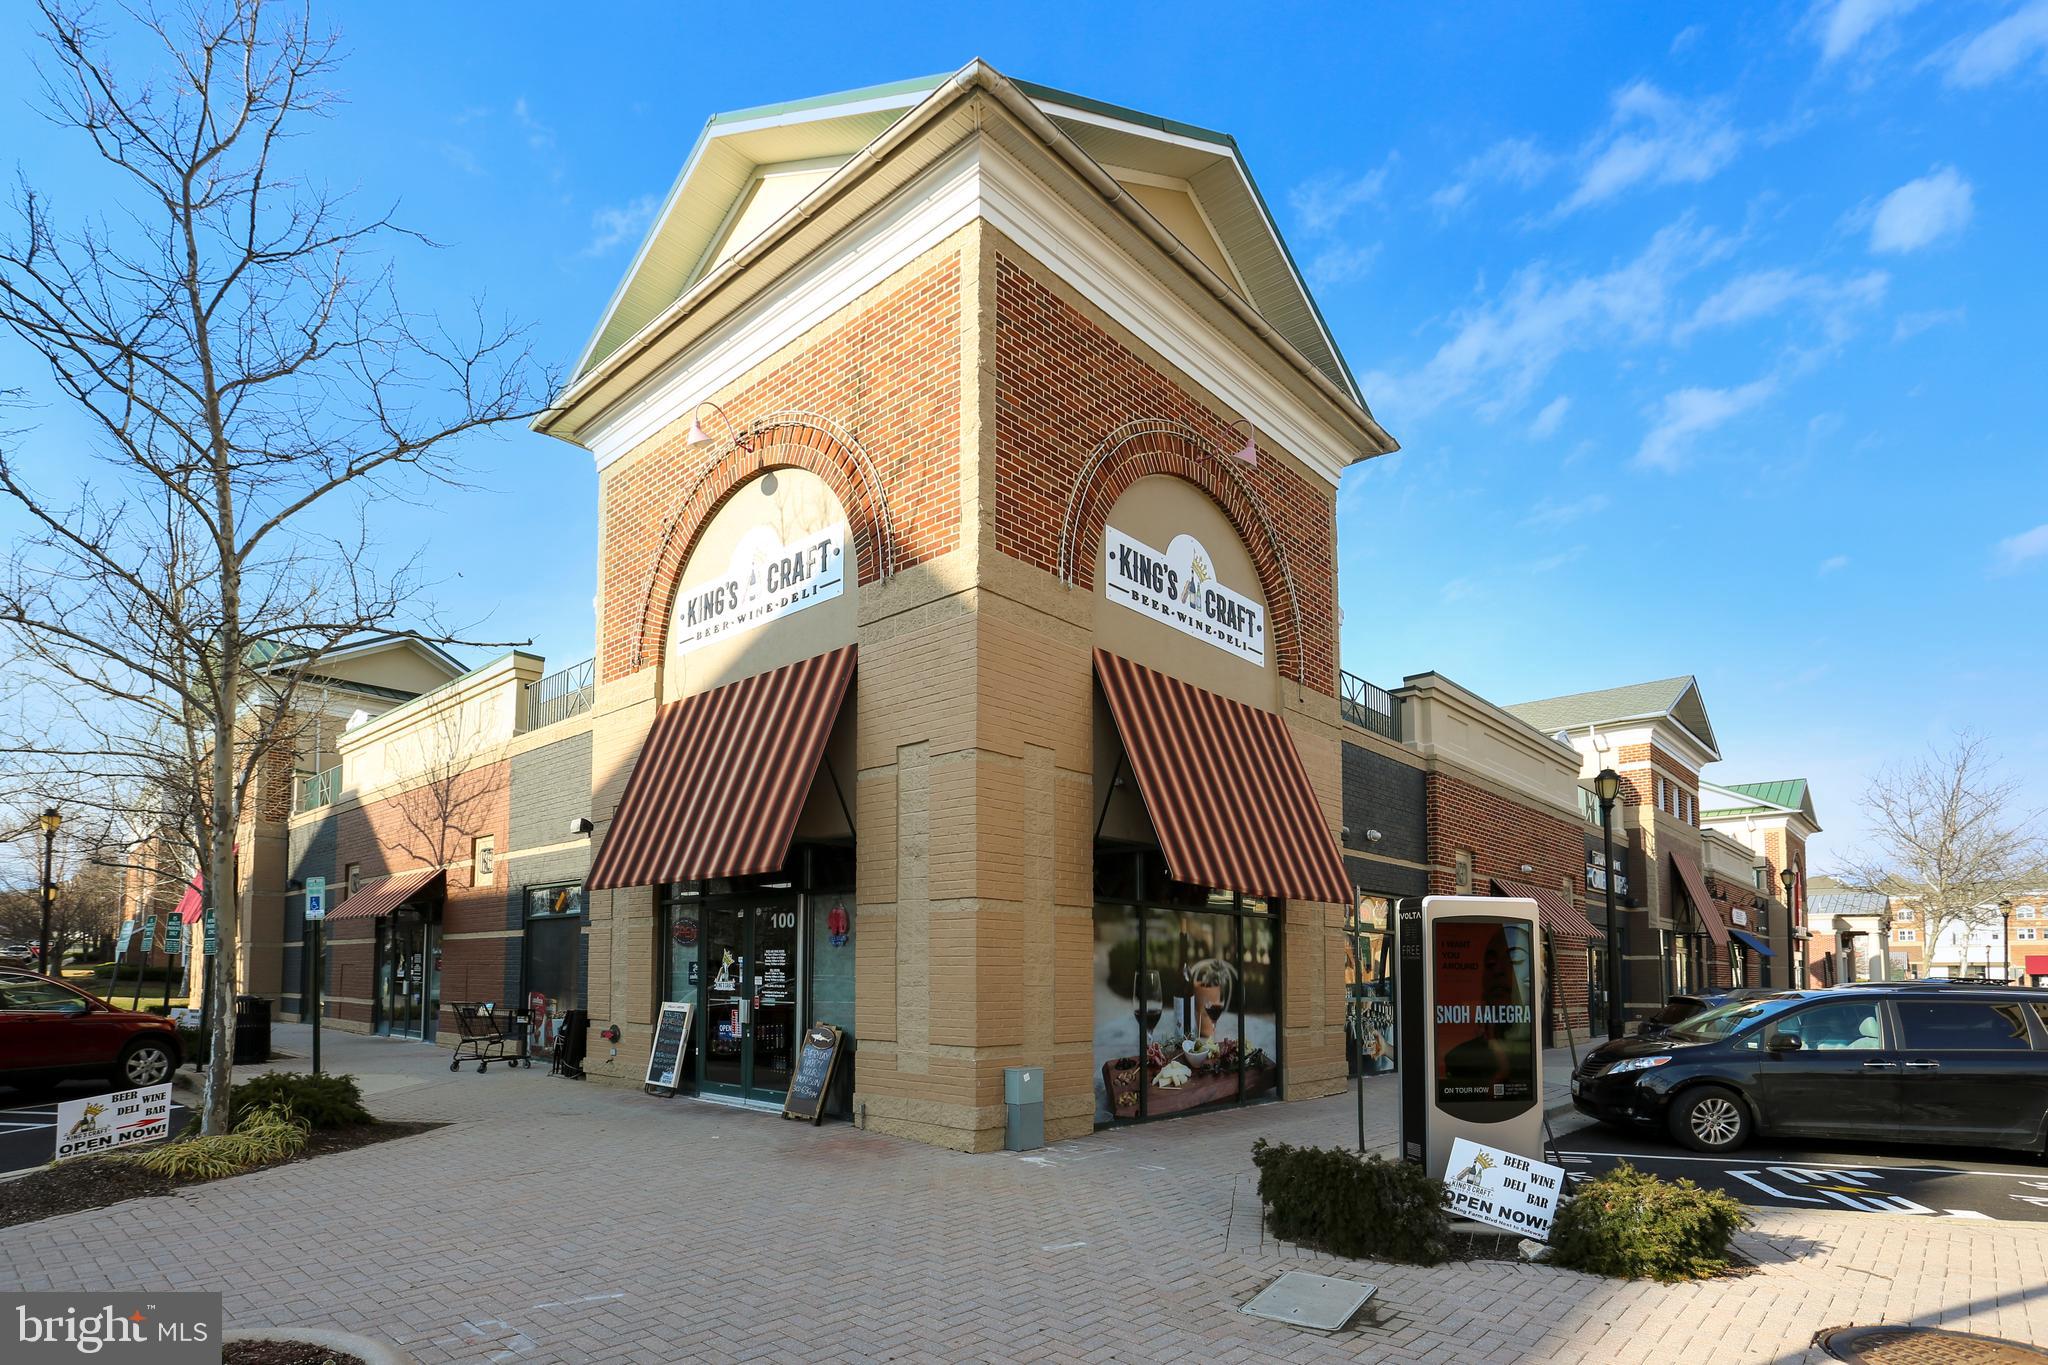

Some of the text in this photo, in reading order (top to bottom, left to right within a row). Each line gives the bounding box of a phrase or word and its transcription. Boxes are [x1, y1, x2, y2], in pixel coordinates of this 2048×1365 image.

[688, 539, 831, 627] KING'S CRAFT
[1120, 544, 1255, 638] KING'S CRAFT
[771, 912, 795, 928] 100
[1400, 911, 1422, 920] VOLTA
[1402, 945, 1421, 955] FREE
[1442, 951, 1460, 959] YOU
[1437, 1005, 1532, 1024] SNOH AALEGRA
[112, 1091, 166, 1103] BEER WINE
[1474, 1086, 1490, 1094] NOW
[117, 1104, 166, 1116] DELI BAR
[60, 1124, 166, 1153] OPEN NOW!
[1504, 1155, 1556, 1190] BEER WINE
[1452, 1180, 1491, 1197] KING'S CRAFT
[1503, 1177, 1549, 1209] DELI BAR
[1443, 1190, 1548, 1231] OPEN NOW!
[1453, 1206, 1467, 1214] King
[1468, 1210, 1484, 1218] Farm
[1484, 1215, 1498, 1223] Blvd
[1499, 1219, 1512, 1228] Next
[1520, 1226, 1545, 1238] Safeway
